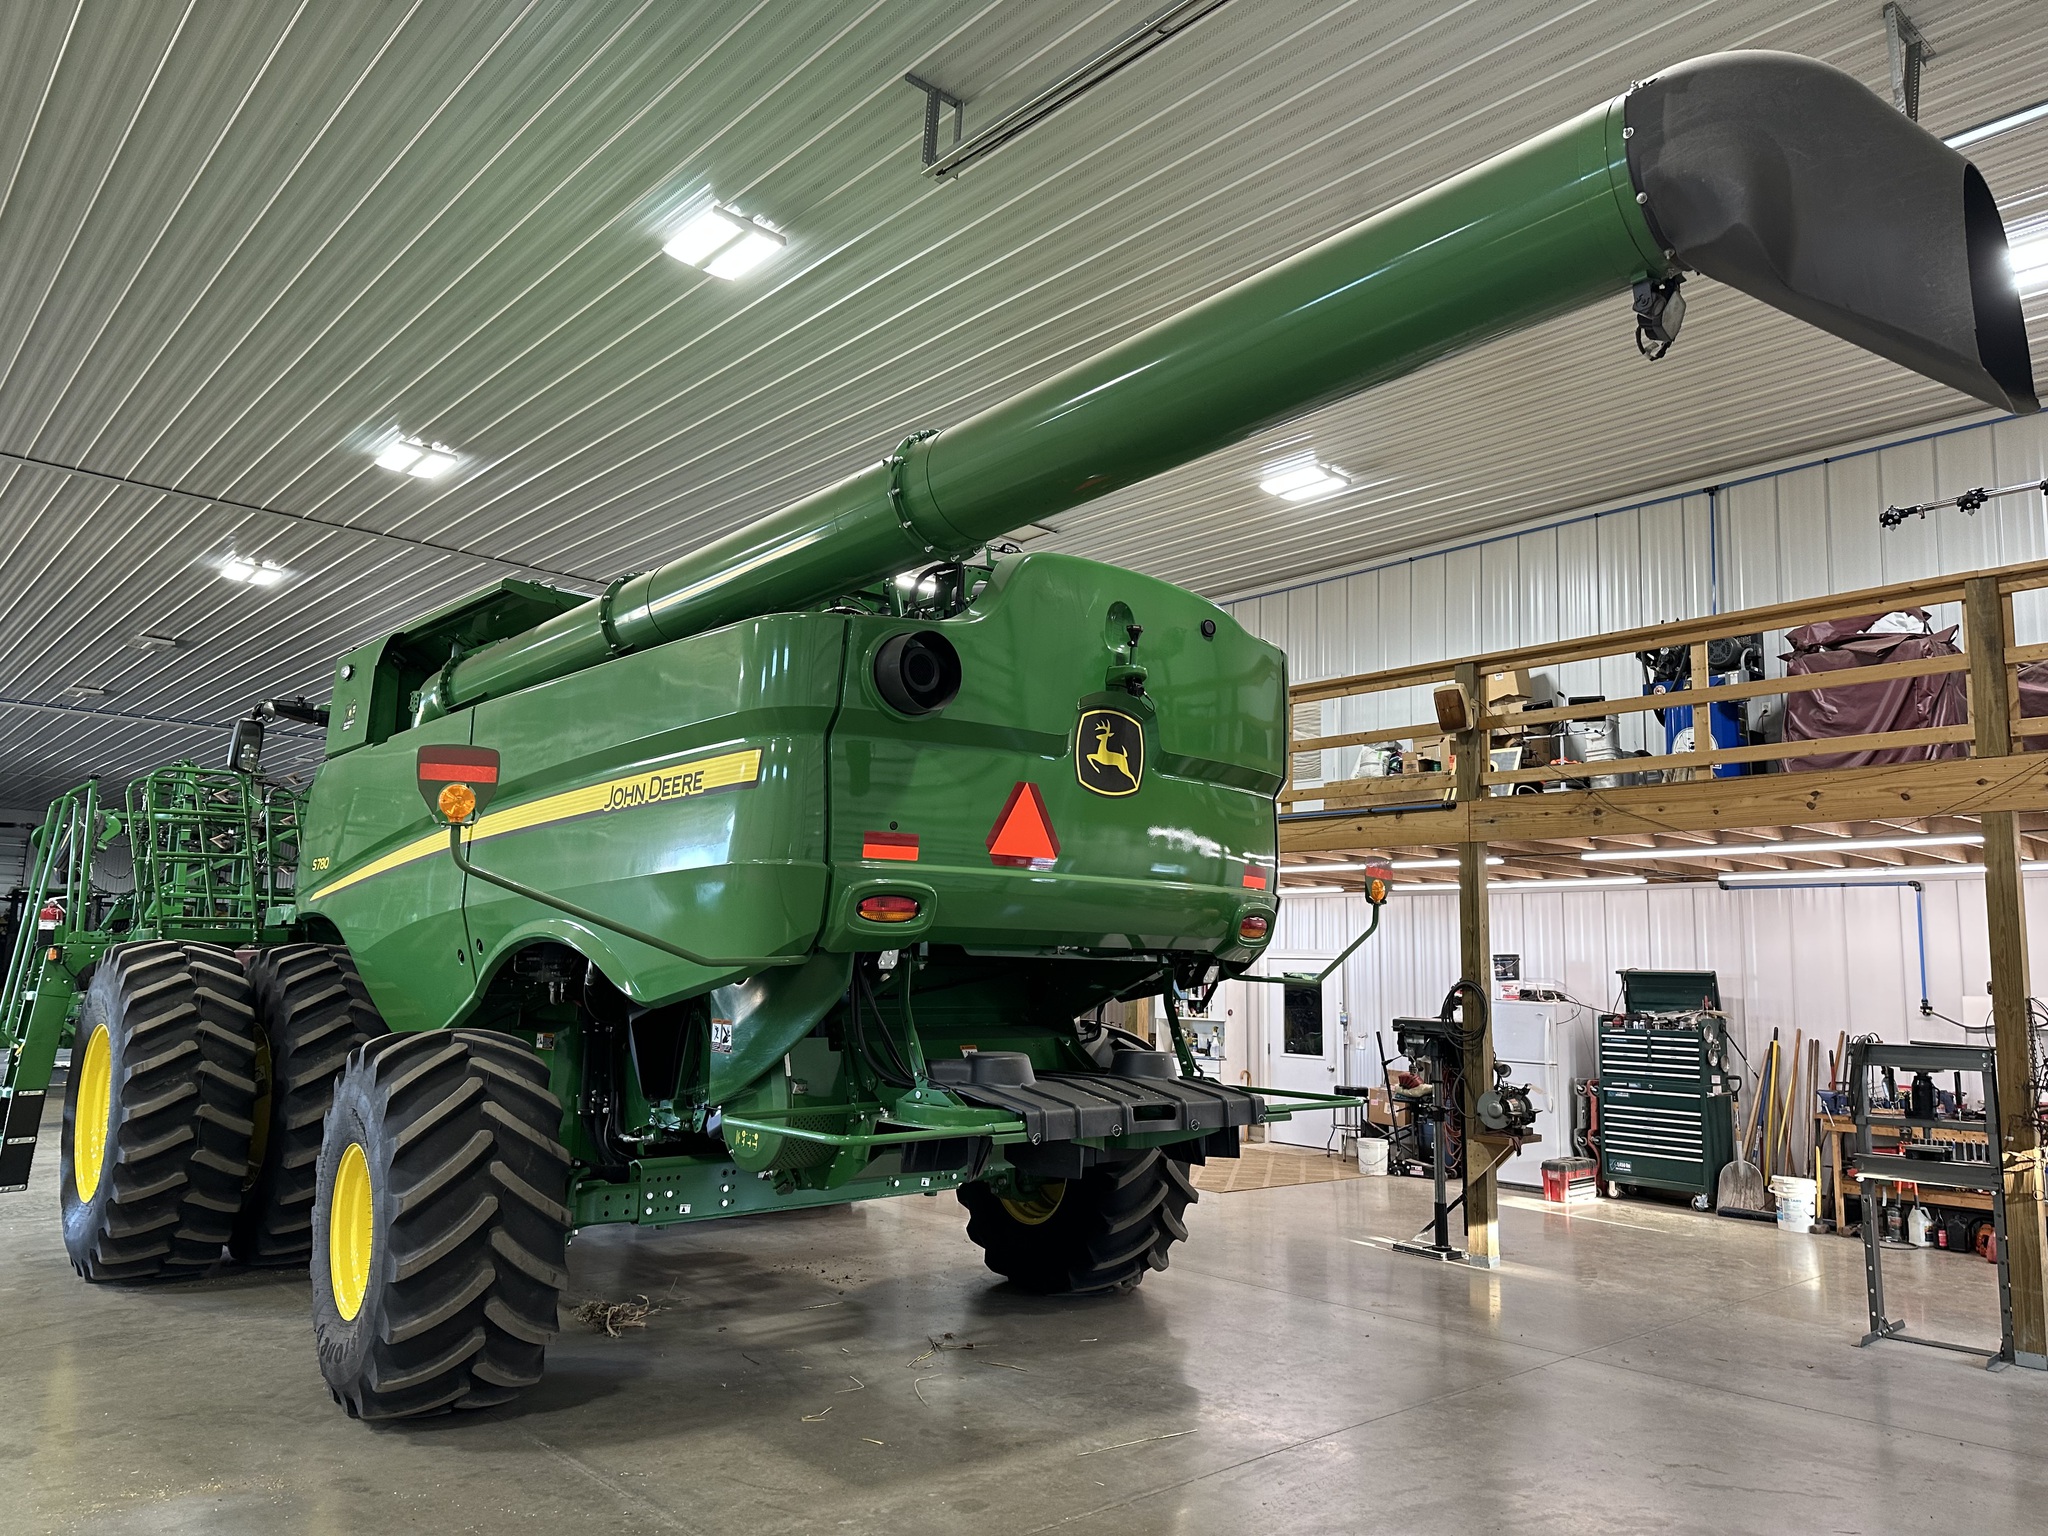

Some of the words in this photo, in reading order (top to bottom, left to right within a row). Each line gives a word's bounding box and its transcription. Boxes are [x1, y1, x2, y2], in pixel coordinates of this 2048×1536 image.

[604, 782, 646, 809] JOHN
[649, 770, 704, 800] DEERE
[311, 856, 330, 871] S780
